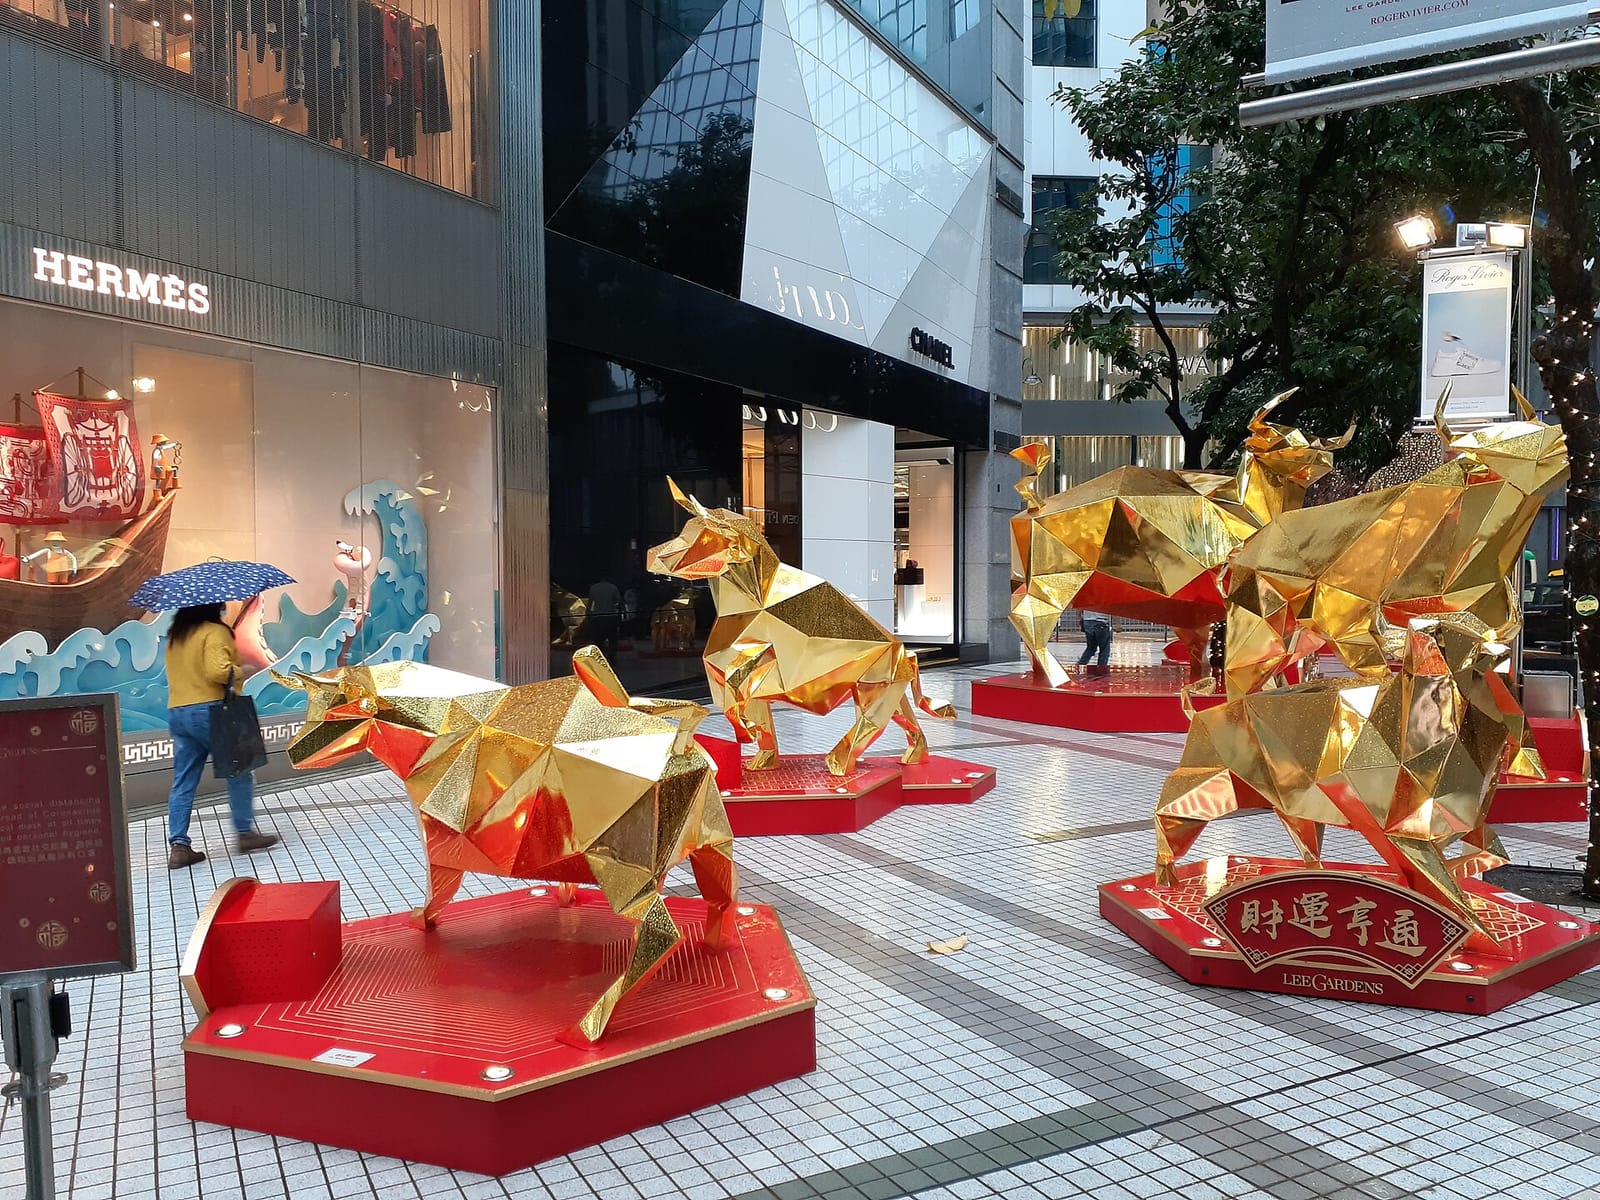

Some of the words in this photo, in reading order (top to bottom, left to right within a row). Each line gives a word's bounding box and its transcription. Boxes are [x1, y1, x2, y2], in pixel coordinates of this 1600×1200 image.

[1345, 5, 1363, 13] LEE
[33, 247, 210, 315] HERMÈS
[1431, 268, 1467, 289] Roger
[1468, 263, 1504, 280] Vivier
[1240, 891, 1427, 958] 財運亨通
